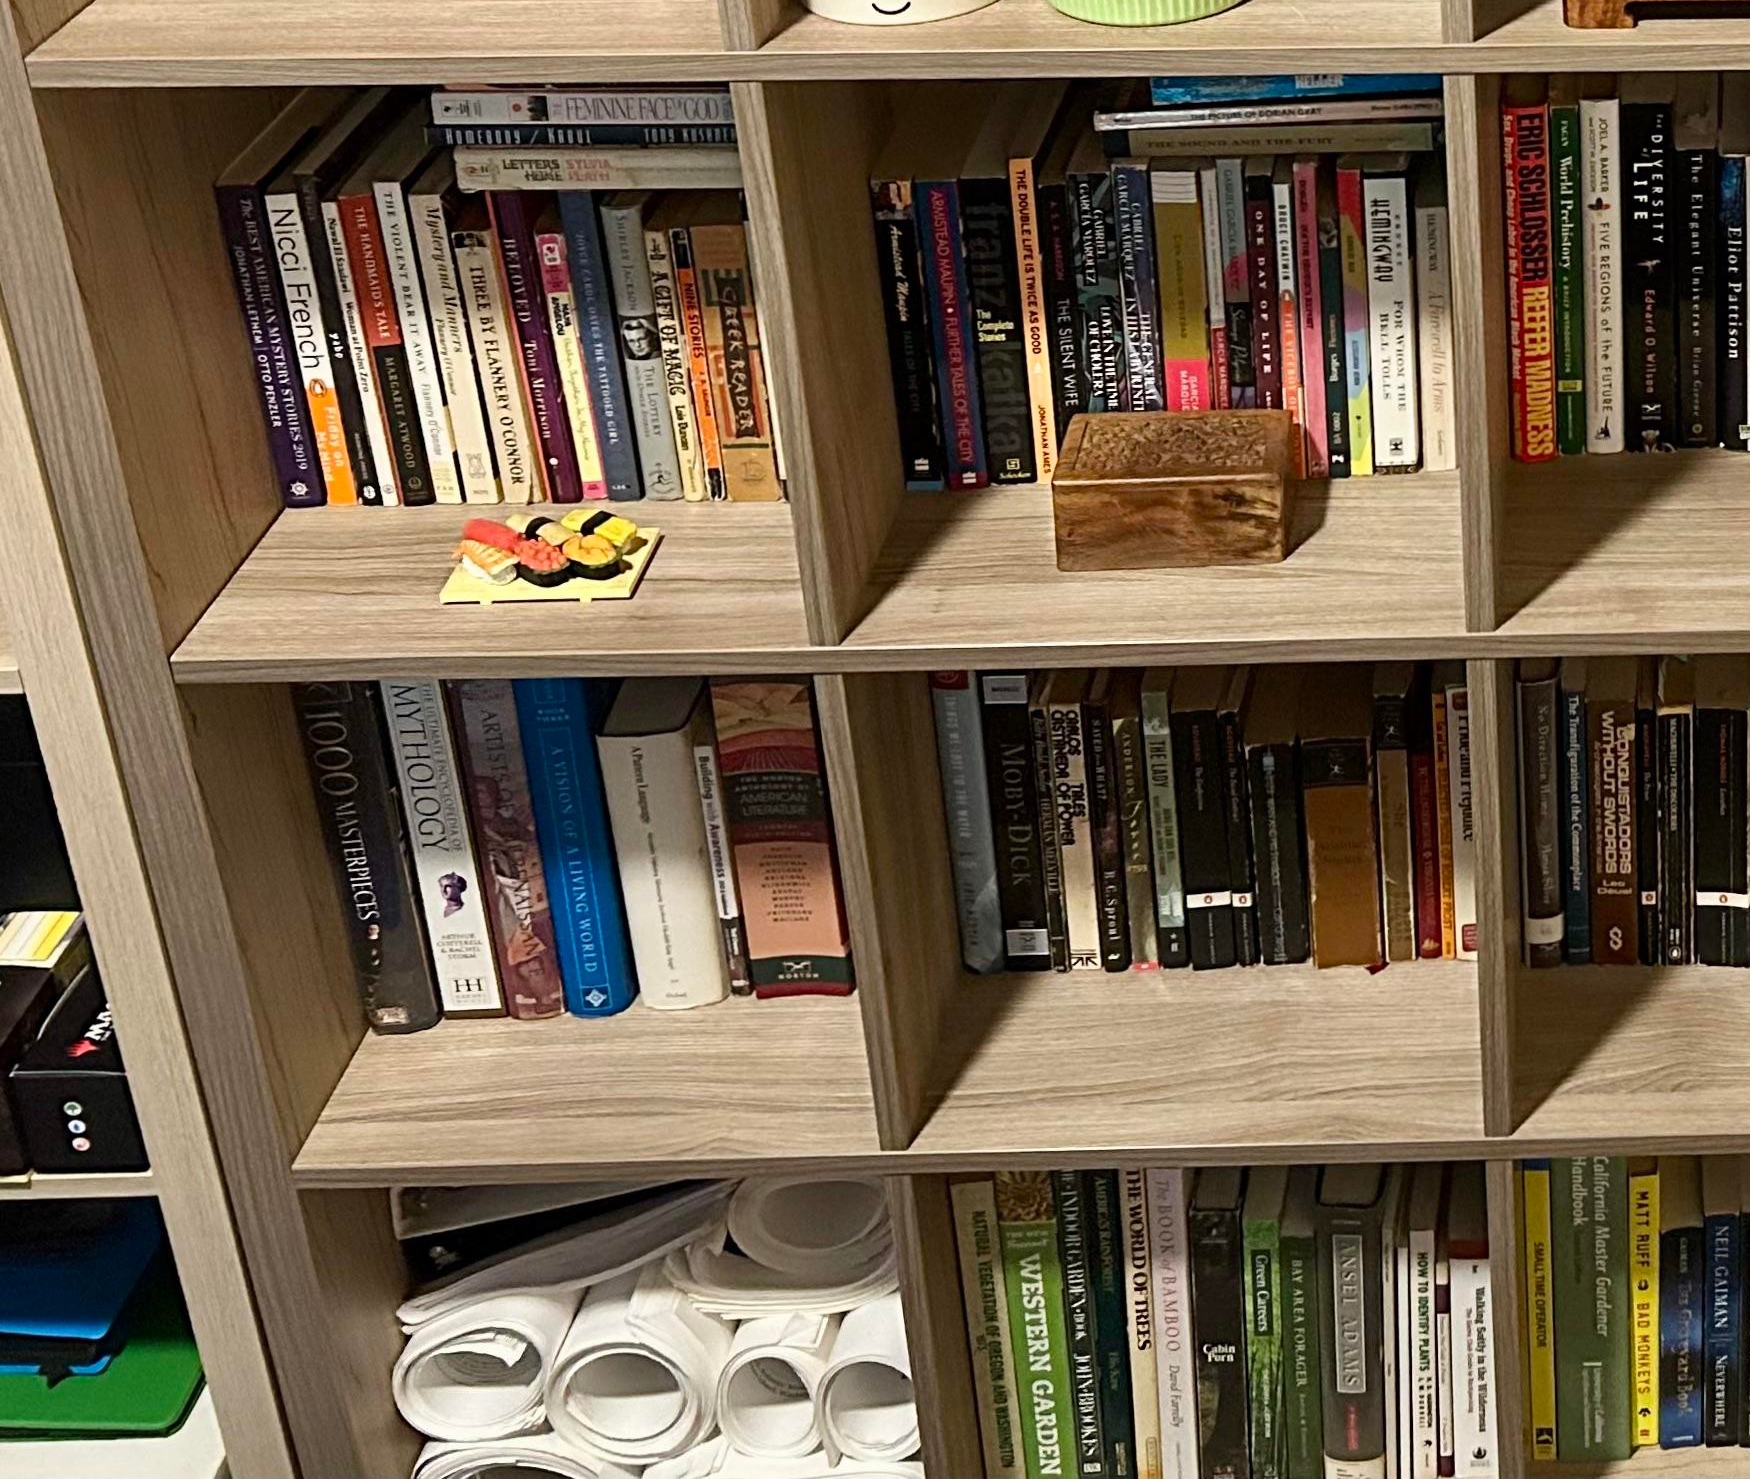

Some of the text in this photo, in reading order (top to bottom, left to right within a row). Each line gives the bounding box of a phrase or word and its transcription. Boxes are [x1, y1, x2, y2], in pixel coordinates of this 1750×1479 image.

[272, 208, 320, 370] Nicci French
[1524, 287, 1553, 458] REEFER MADNESS
[391, 685, 449, 852] MYTHOLOGY
[1018, 1255, 1062, 1476] WESTERN GARDEN
[1636, 1303, 1651, 1395] BAD MONKEYS
